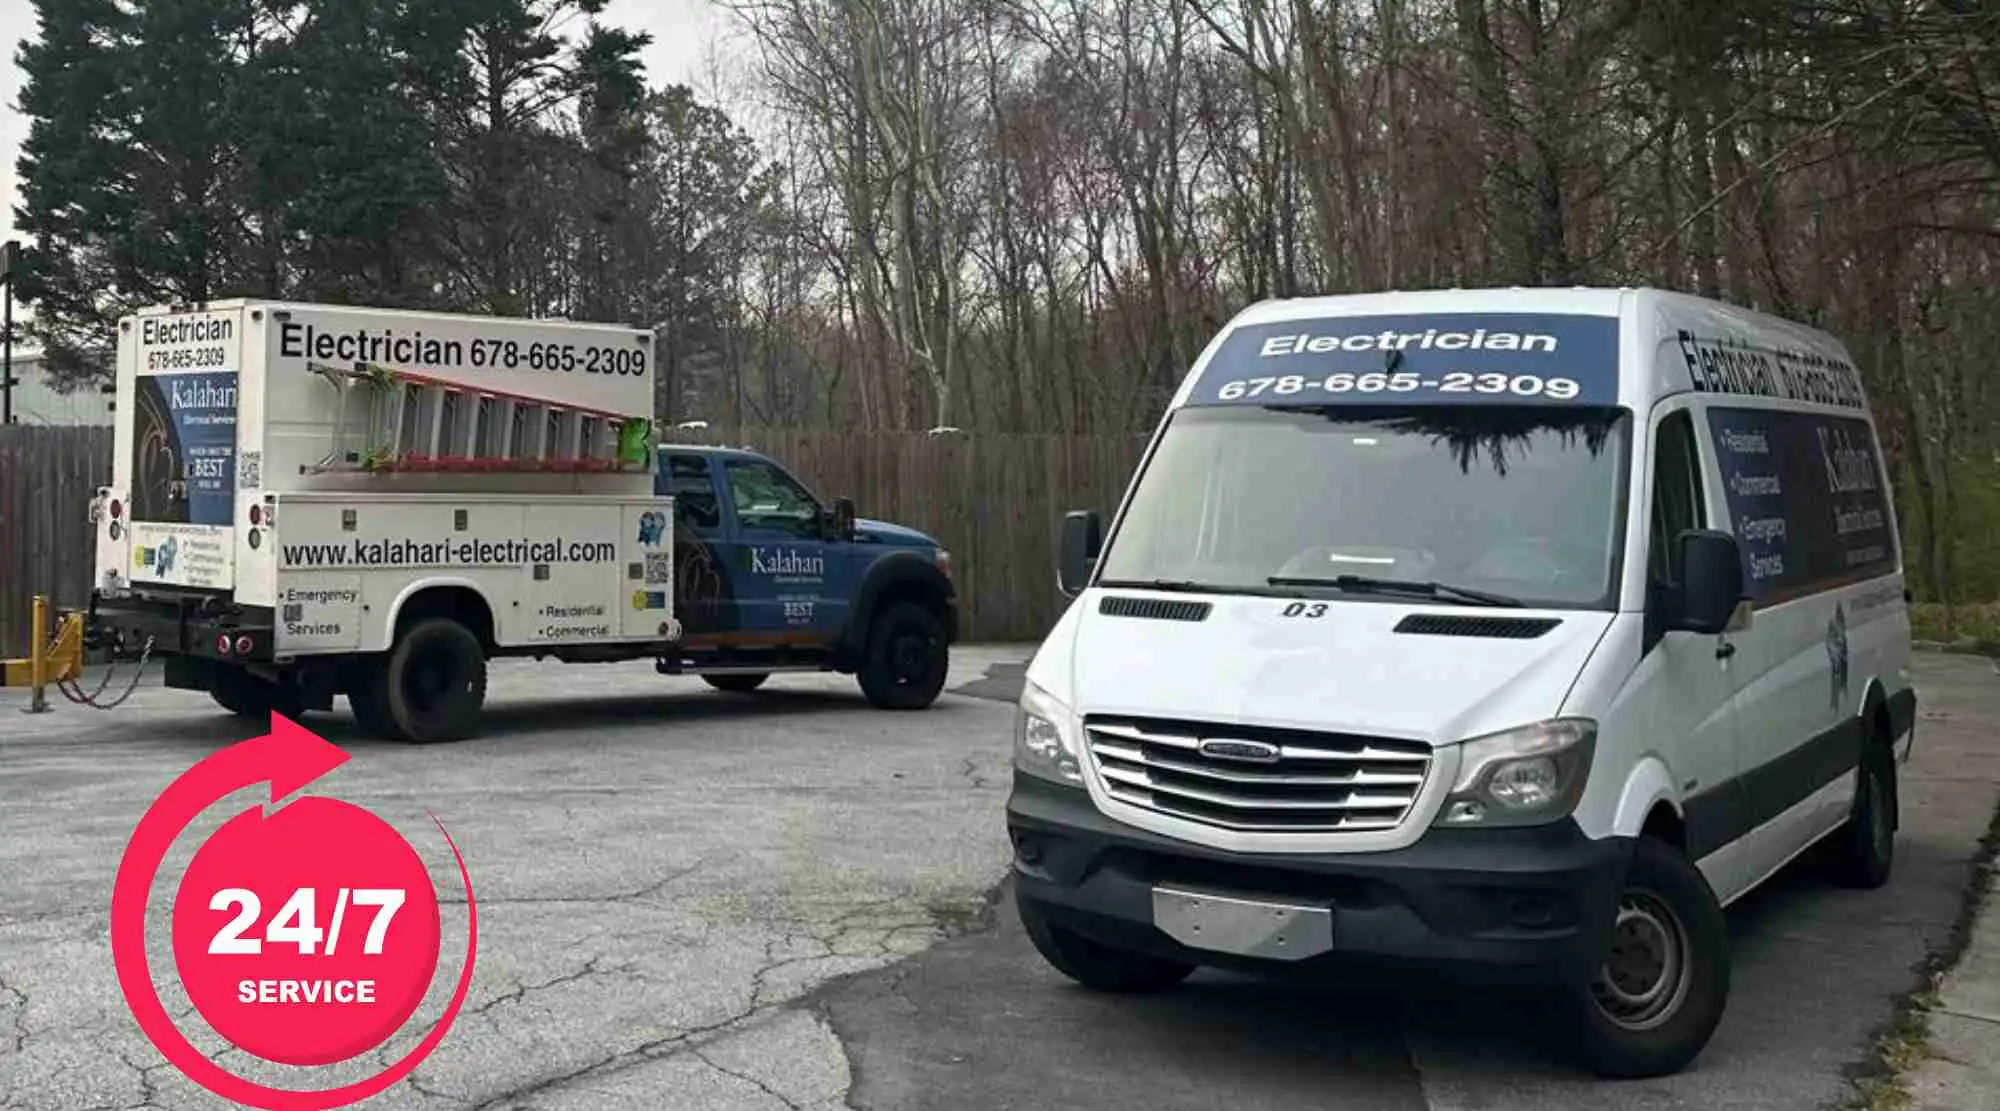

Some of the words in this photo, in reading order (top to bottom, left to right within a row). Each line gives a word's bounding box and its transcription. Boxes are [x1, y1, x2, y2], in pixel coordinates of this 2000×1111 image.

[143, 317, 232, 346] Electrician
[1260, 328, 1558, 358] Electrician
[280, 323, 462, 366] Electrician
[471, 339, 645, 376] 678-665-2309
[172, 379, 237, 410] Kalahari
[1217, 372, 1580, 400] 678-665-2309
[195, 458, 226, 477] BEST
[283, 538, 616, 565] www.kalahari-electrical.com
[752, 547, 824, 574] Kalahari
[287, 588, 358, 604] Emergency
[784, 602, 815, 617] BEST
[546, 605, 604, 618] Residential
[1283, 602, 1329, 619] 03
[287, 622, 341, 636] Services
